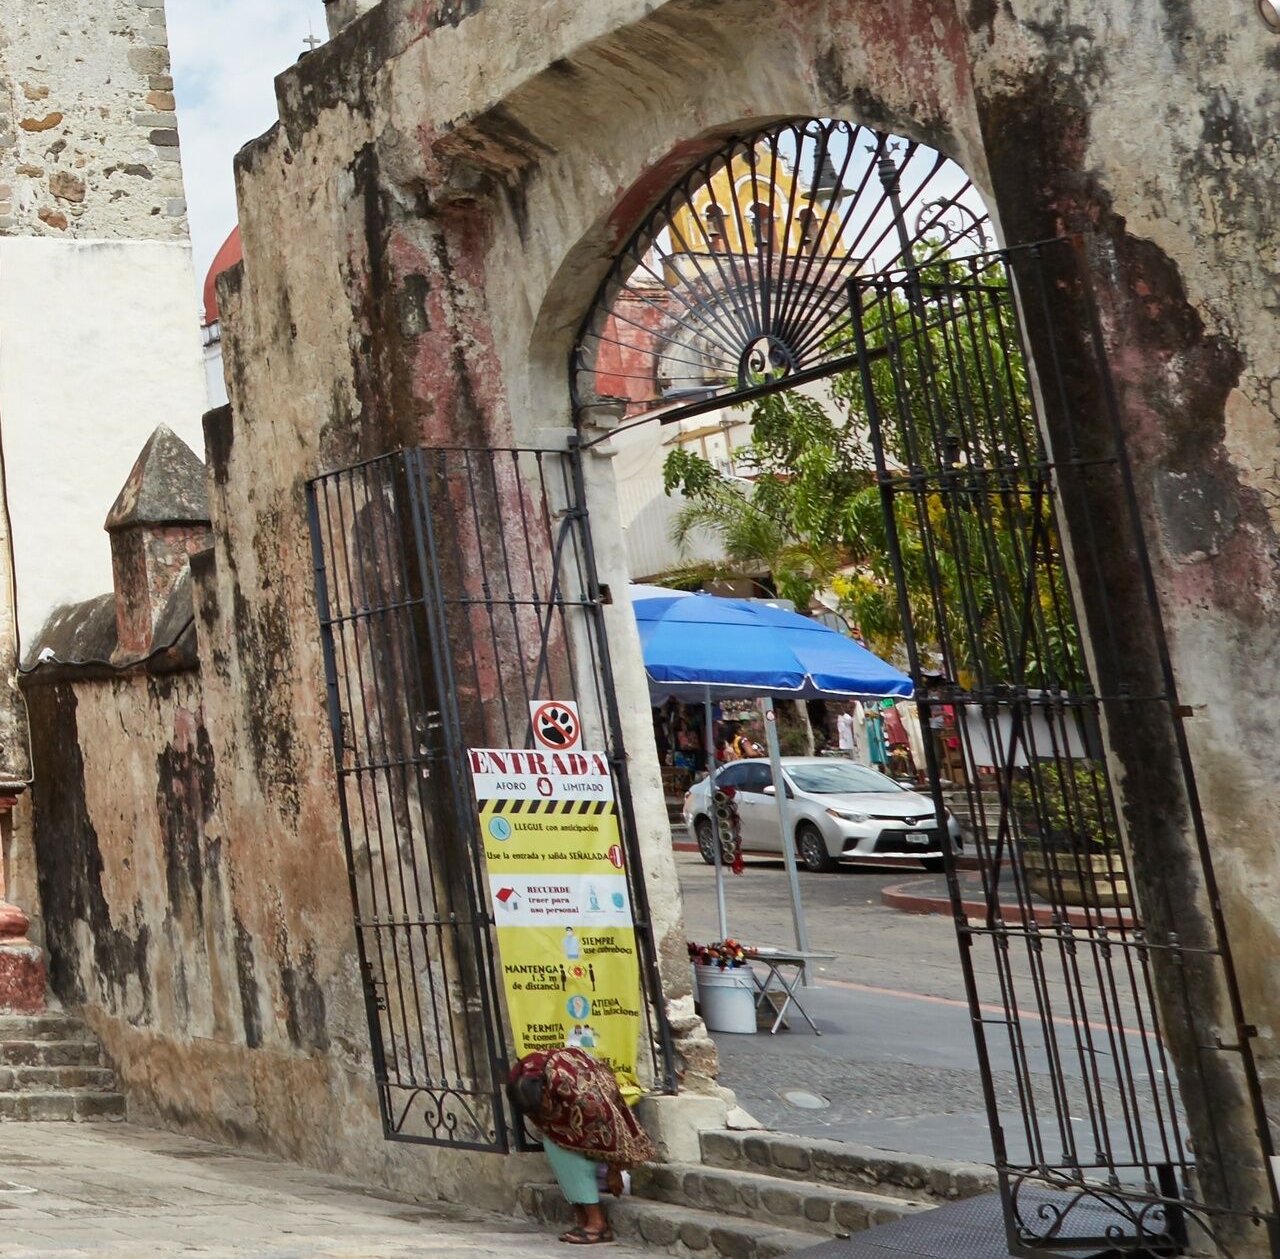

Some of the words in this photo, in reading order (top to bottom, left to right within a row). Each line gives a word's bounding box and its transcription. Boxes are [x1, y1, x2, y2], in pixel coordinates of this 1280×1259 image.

[471, 751, 608, 775] ENTRADA
[496, 782, 526, 790] AFORO
[563, 782, 604, 792] LIMITADO
[514, 823, 543, 831] LLEGUE
[487, 851, 501, 860] Use
[503, 851, 510, 860] la
[512, 851, 539, 860] entrada
[548, 851, 567, 860] salida
[569, 851, 609, 860] SEÑALADA
[546, 906, 579, 914] personal
[582, 936, 615, 946] SIEMPRE
[505, 964, 558, 974] MANTENGA
[532, 974, 545, 982] 1.5
[512, 981, 522, 990] de
[525, 982, 560, 990] distancia
[527, 1023, 564, 1033] PERMITA
[522, 1032, 532, 1041] le
[532, 1033, 557, 1041] tomen
